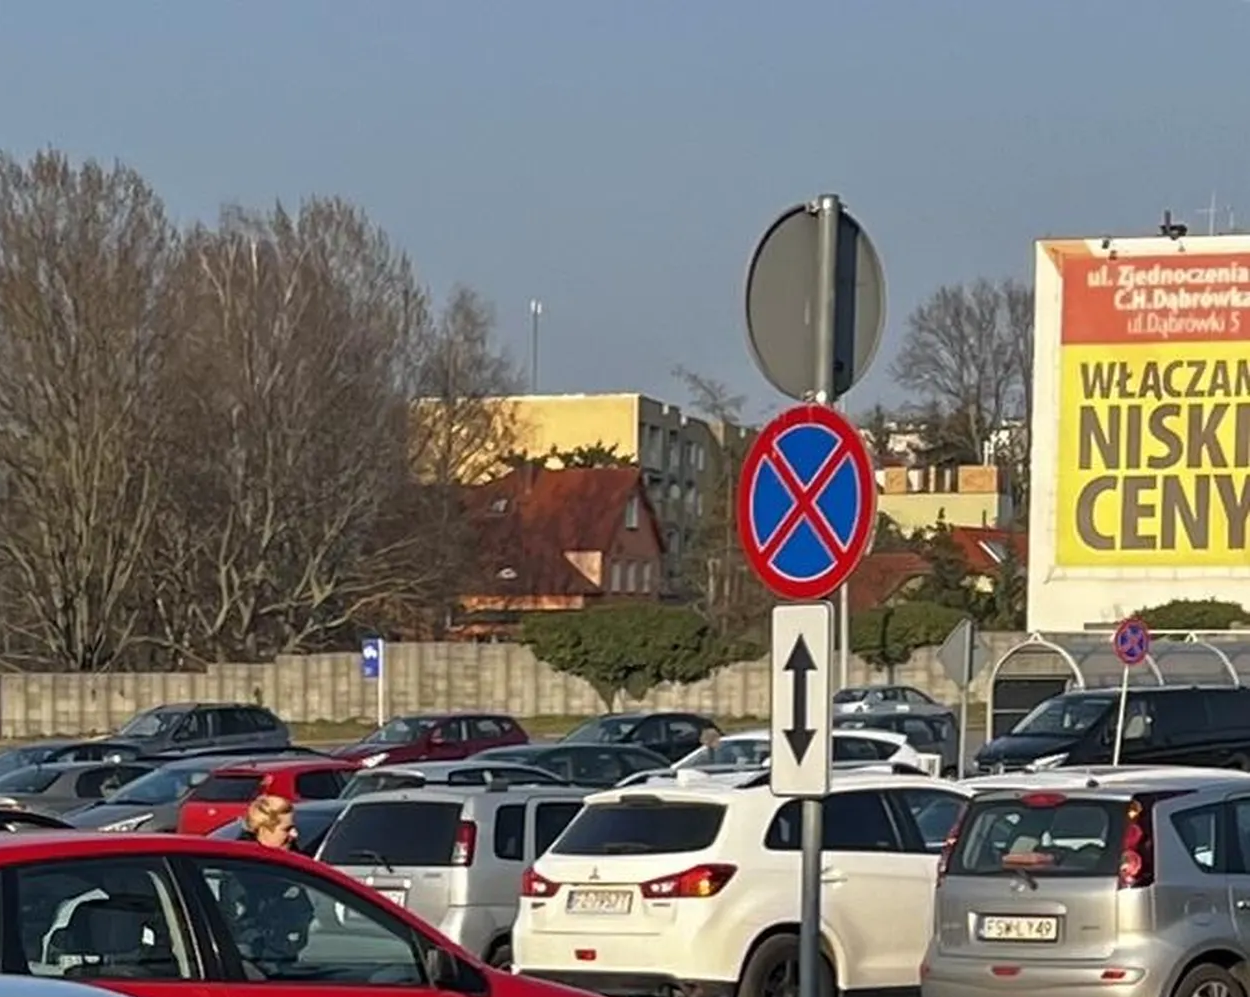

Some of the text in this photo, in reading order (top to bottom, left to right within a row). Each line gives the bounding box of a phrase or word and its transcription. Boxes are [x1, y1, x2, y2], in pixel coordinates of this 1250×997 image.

[1087, 261, 1249, 291] ul. Zjednoczenia
[1229, 311, 1241, 333] 5
[1078, 402, 1250, 470] NISKI
[1075, 474, 1250, 550] CENY
